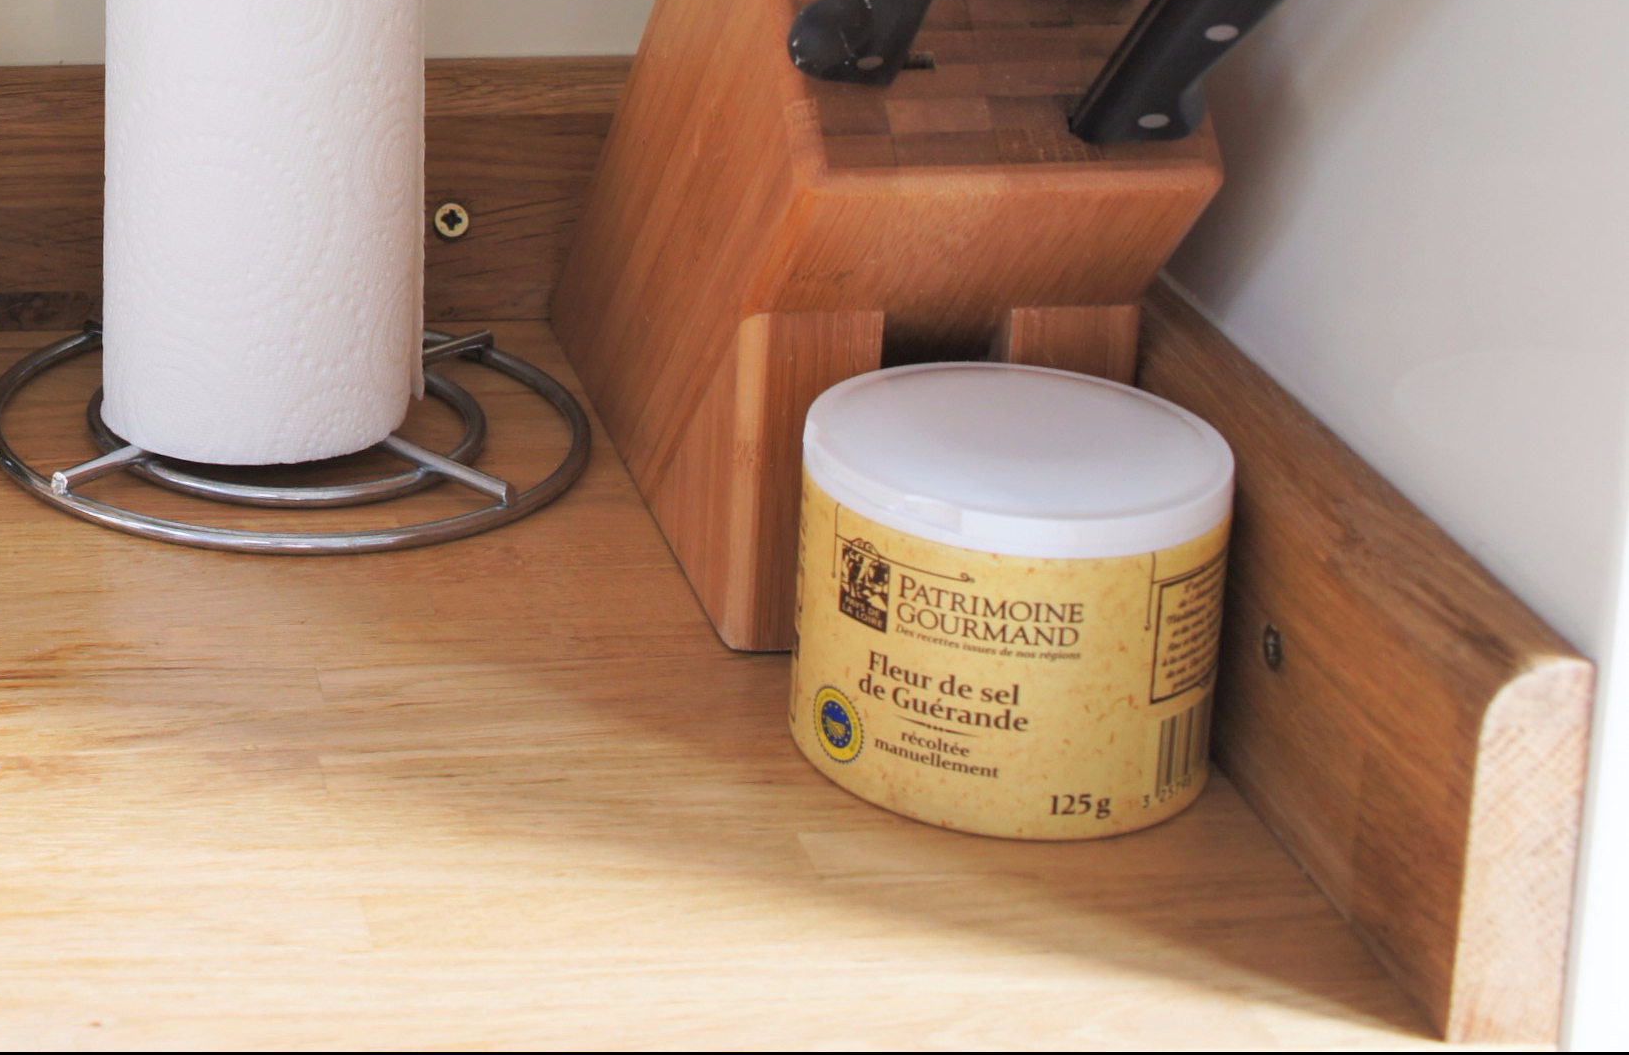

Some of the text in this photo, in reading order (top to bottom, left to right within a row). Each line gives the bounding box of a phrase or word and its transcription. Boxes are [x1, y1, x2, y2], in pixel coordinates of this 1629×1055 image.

[898, 572, 1085, 624] PATRIMOINE
[895, 624, 1082, 662] Des recettes issues de nos régions
[896, 601, 1081, 647] GOURMAND
[868, 649, 1020, 706] Fleur de sel
[858, 673, 886, 702] de
[891, 685, 1030, 732] Guérande
[874, 737, 1000, 779] manuellement
[900, 730, 971, 758] récoltée
